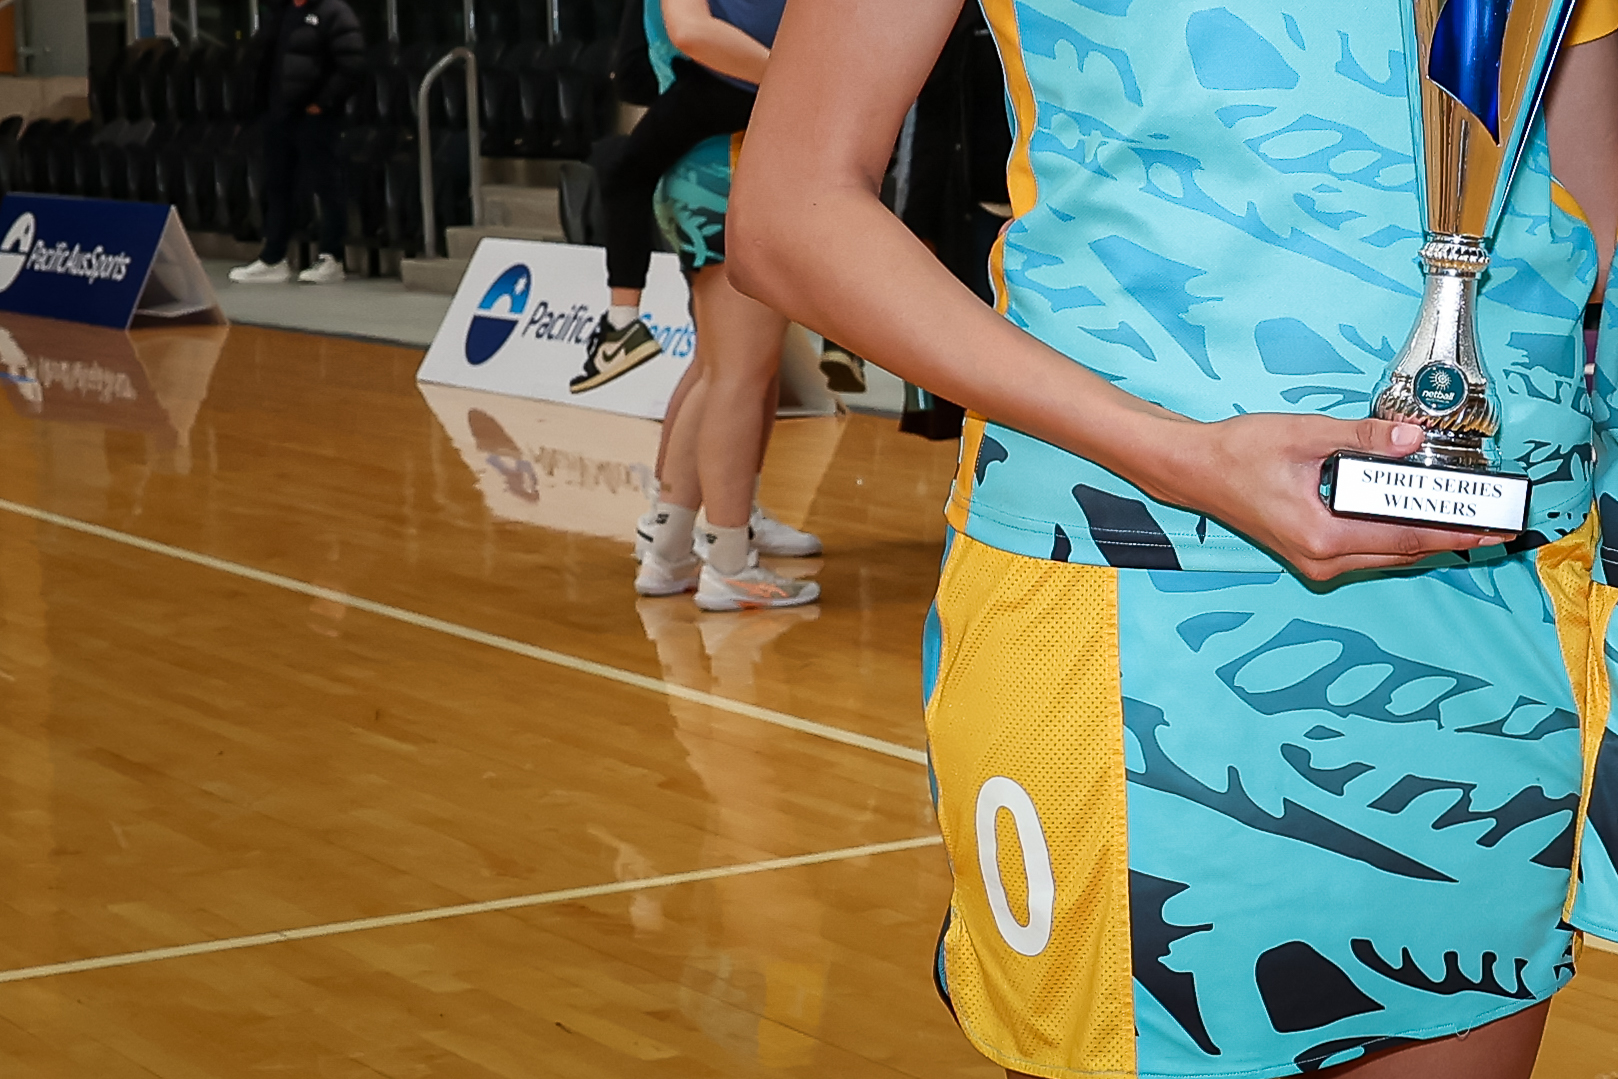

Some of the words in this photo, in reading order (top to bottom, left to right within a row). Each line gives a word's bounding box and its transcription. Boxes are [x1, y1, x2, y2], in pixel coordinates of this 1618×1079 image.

[1421, 389, 1456, 401] netball
[1361, 468, 1428, 490] SPIRIT
[1432, 477, 1503, 499] SERIES
[1384, 493, 1477, 518] WINNERS
[975, 776, 1056, 956] 0
